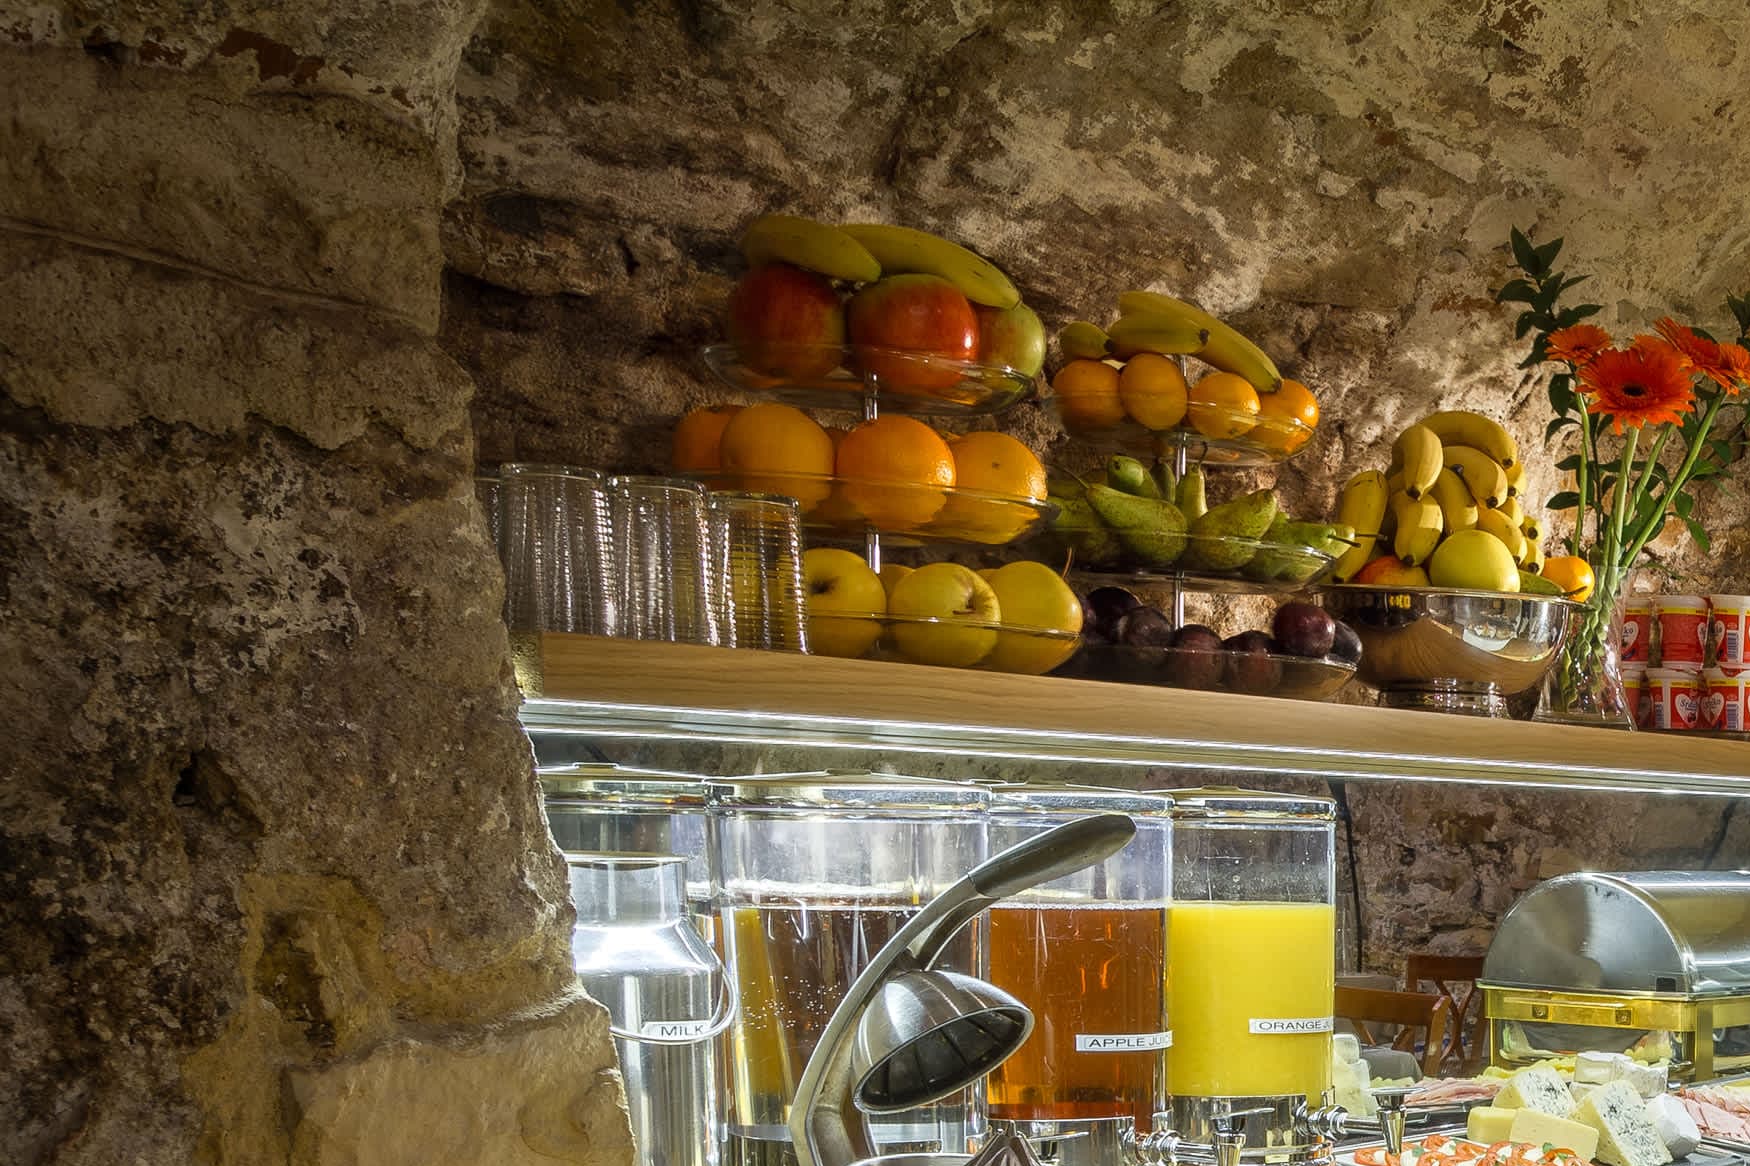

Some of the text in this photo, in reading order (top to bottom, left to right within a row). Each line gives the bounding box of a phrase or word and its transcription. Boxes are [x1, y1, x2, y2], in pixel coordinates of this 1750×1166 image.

[661, 1025, 704, 1037] MILK
[1259, 1020, 1322, 1031] ORANGE
[1089, 1038, 1145, 1048] APPLE
